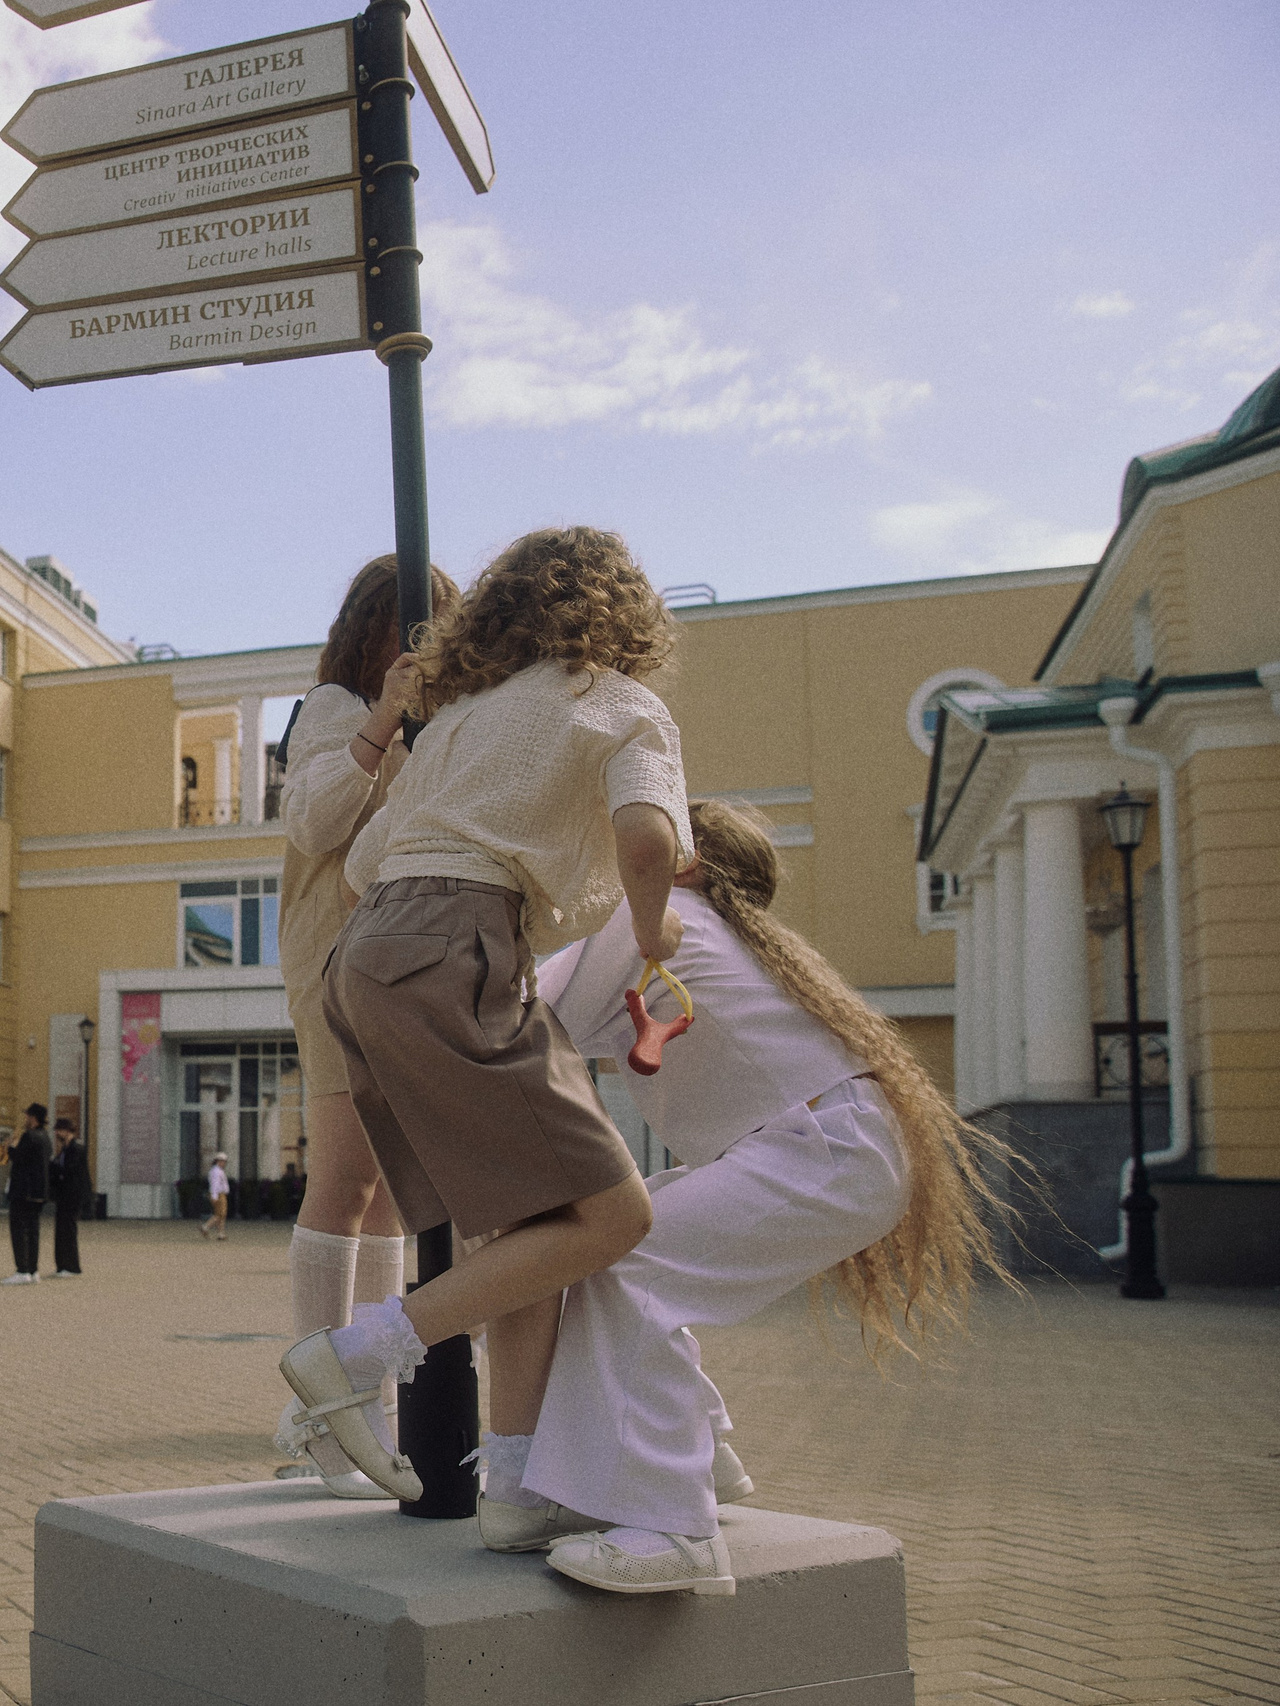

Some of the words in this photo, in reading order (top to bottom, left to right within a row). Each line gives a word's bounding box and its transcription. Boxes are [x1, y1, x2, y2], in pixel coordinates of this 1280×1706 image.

[184, 48, 305, 91] ГАЛЕРЕЯ
[136, 102, 196, 125] Sinara
[202, 92, 232, 111] Art
[237, 79, 306, 103] Gallery
[104, 155, 170, 181] ЦЕНТР
[175, 125, 309, 165] ТВОРЧЕСКИХ
[177, 144, 310, 184] ИНИЦИАТИВ
[123, 189, 178, 212] Creativ
[184, 175, 256, 199] nitiatives
[260, 164, 311, 184] Center
[157, 207, 311, 250] ЛЕКТОРИИ
[187, 247, 259, 271] Lecture
[265, 236, 312, 258] halls
[69, 304, 191, 339] БАРМИН
[199, 289, 315, 321] СТУДИЯ
[170, 327, 242, 351] Barmin
[249, 319, 317, 343] Design
